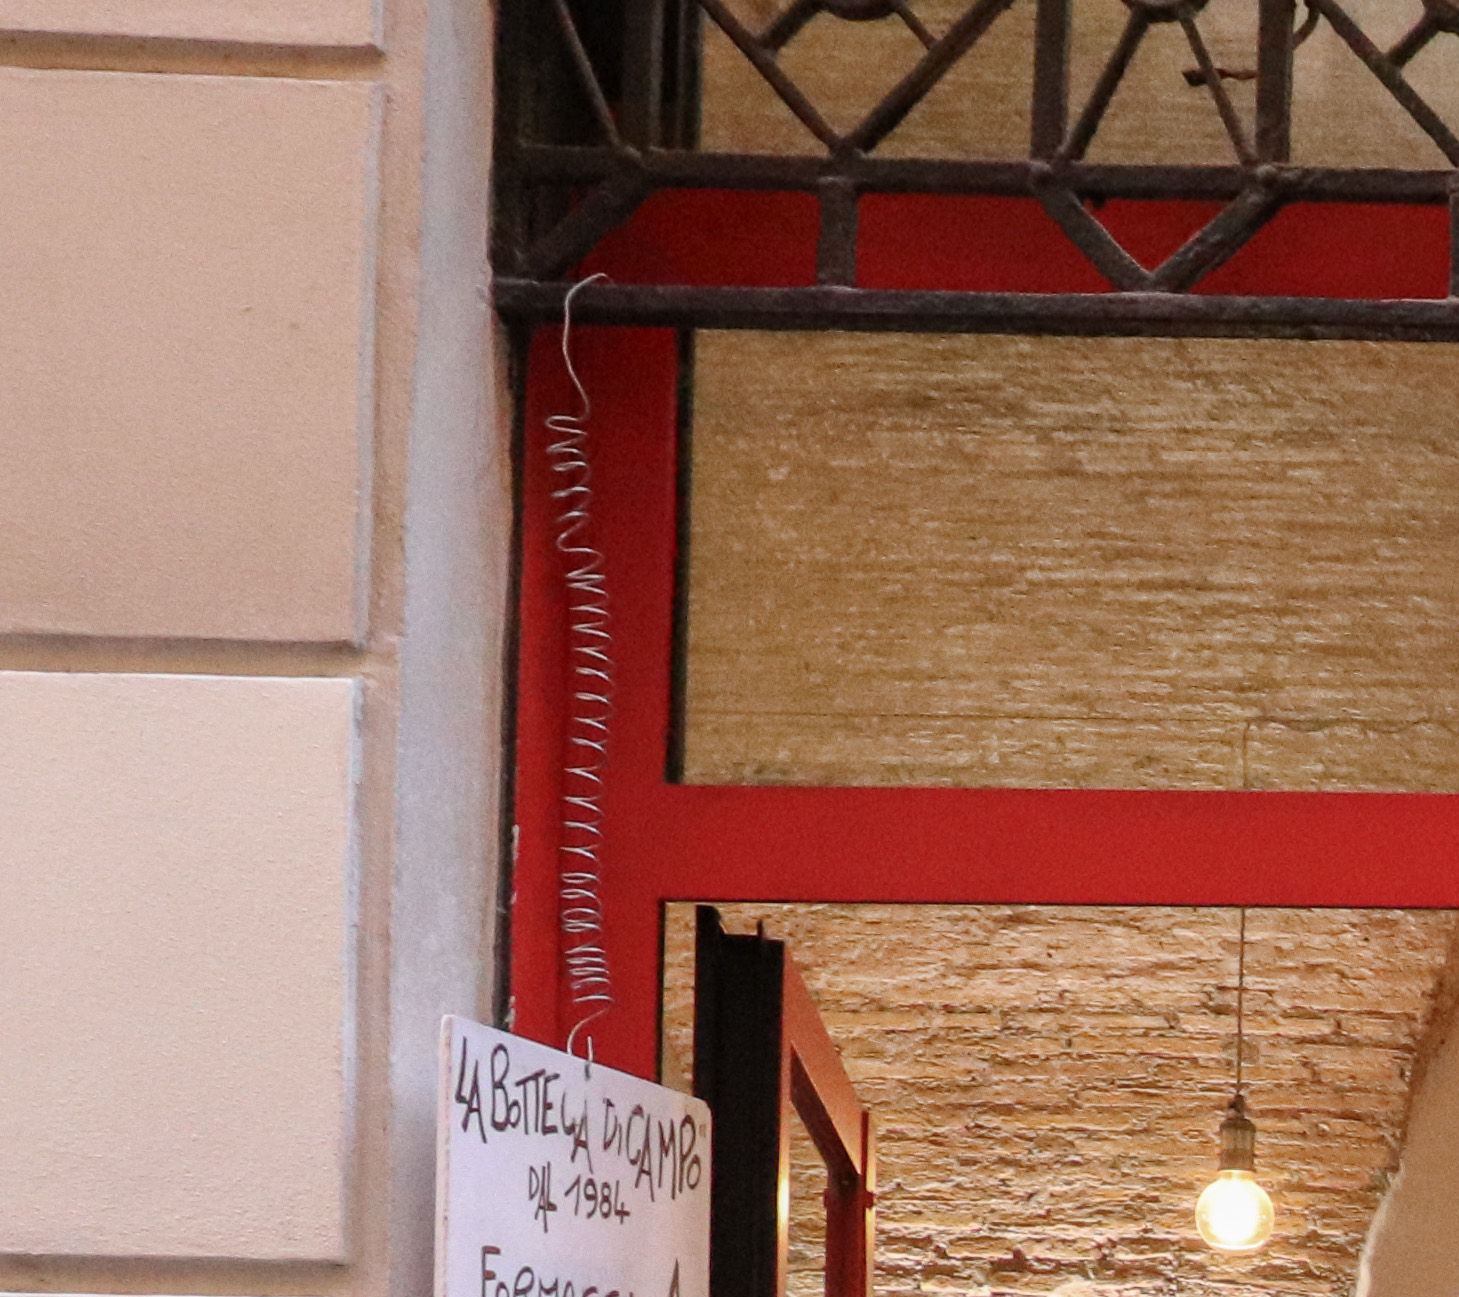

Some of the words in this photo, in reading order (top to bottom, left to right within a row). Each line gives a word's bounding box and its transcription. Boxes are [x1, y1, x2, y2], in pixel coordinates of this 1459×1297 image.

[455, 1036, 487, 1144] LA
[528, 1162, 557, 1233] DAL
[565, 1174, 631, 1224] 1984
